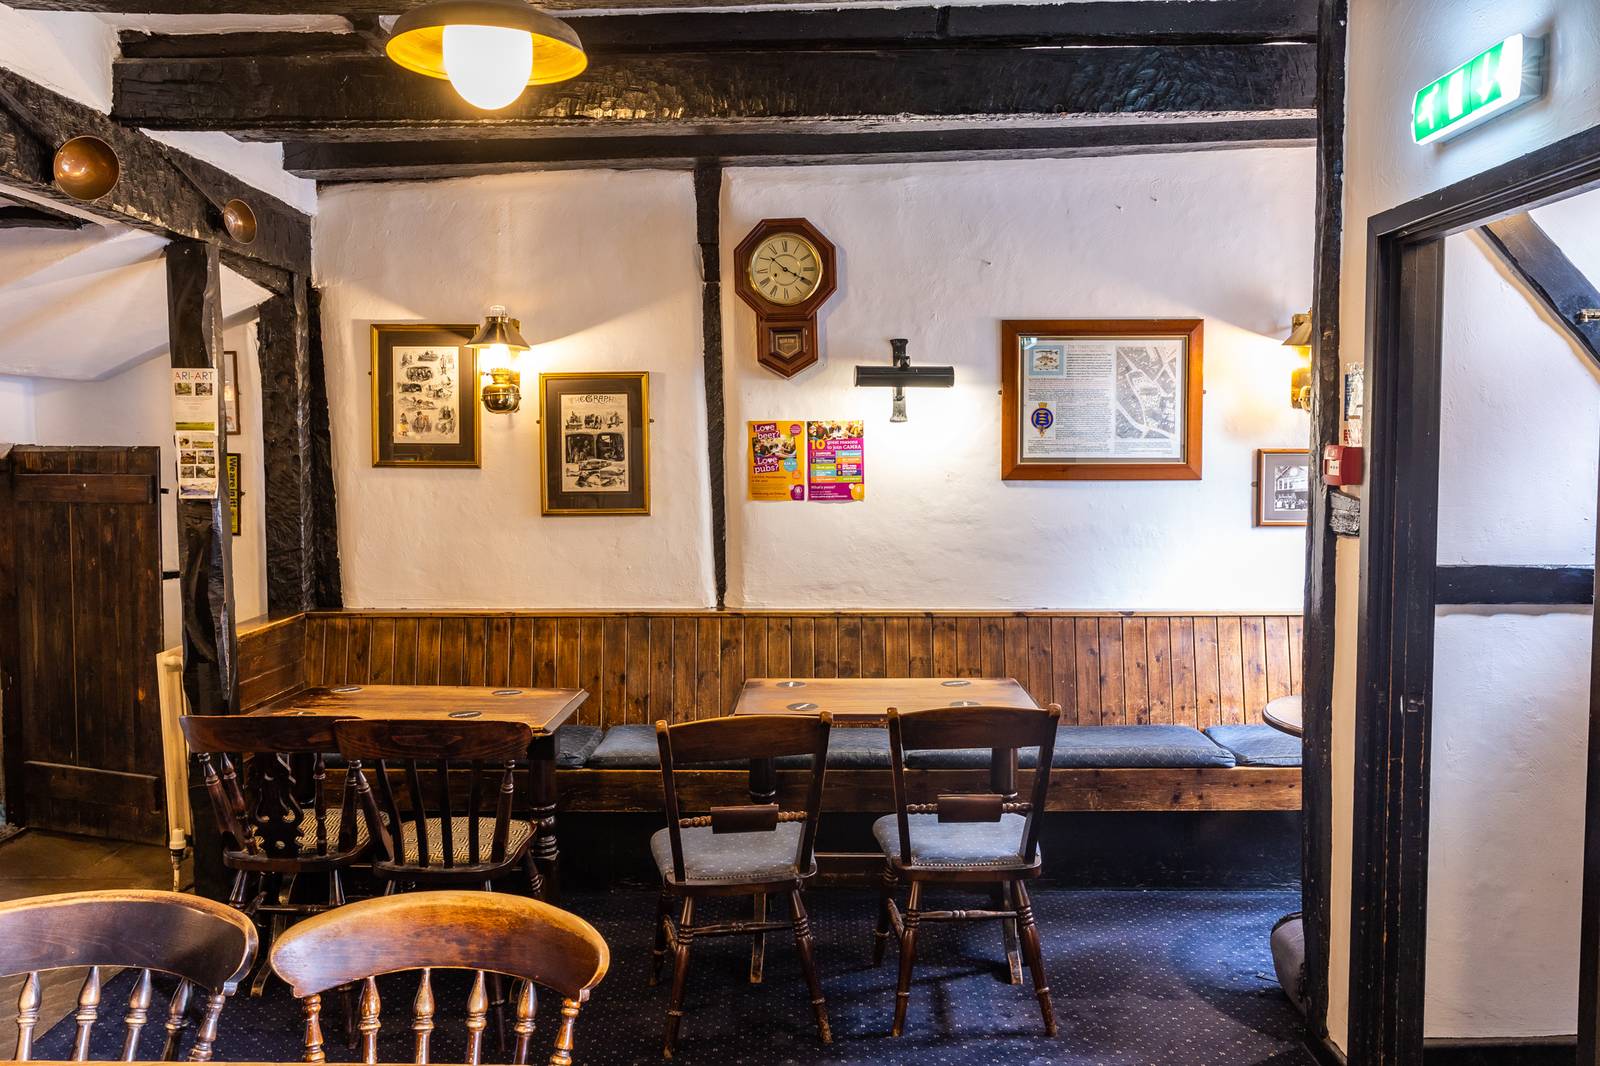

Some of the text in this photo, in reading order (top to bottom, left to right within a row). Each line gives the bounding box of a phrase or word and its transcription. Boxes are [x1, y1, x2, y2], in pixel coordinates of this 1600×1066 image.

[175, 371, 213, 381] ARI-ART
[754, 424, 775, 432] Love
[757, 430, 780, 440] beer?
[809, 439, 825, 450] 10
[757, 456, 778, 465] Love
[754, 463, 779, 474] pubs?
